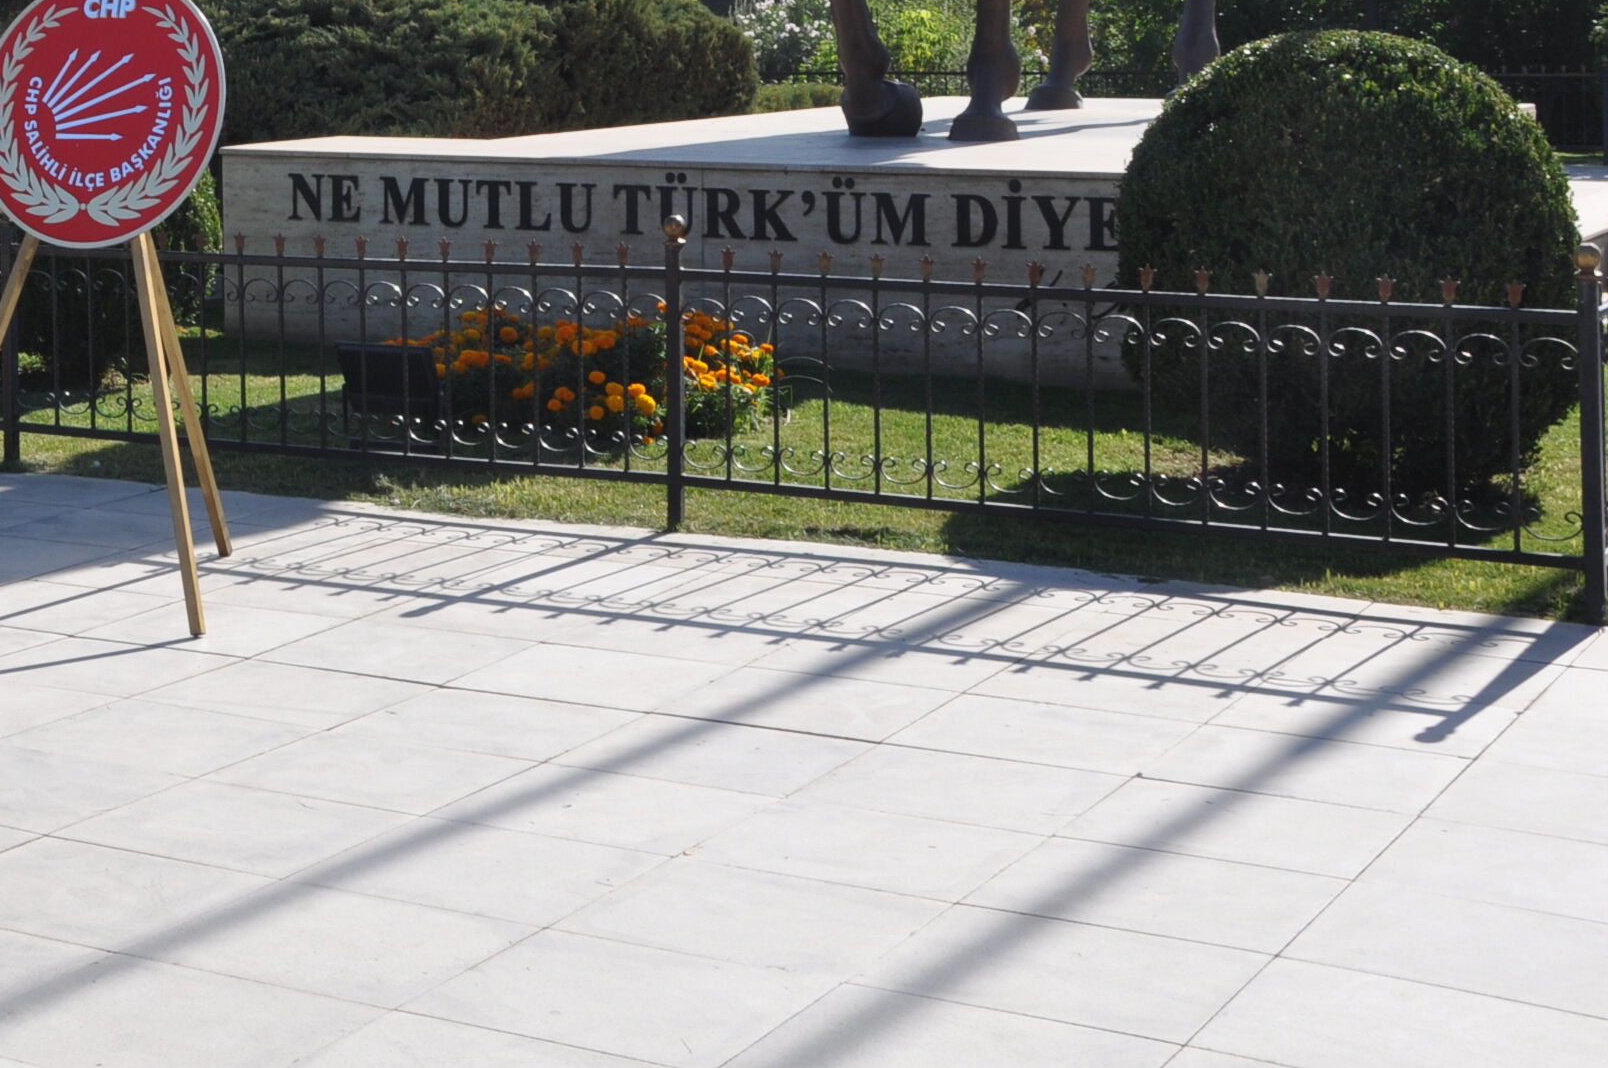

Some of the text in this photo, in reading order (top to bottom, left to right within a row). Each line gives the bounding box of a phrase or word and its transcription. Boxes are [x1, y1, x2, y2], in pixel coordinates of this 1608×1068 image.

[24, 76, 173, 192] CHP SALİHLİ İLÇE BAŞKANLIĞI
[288, 173, 362, 223] NE
[379, 176, 597, 233] MUTLU
